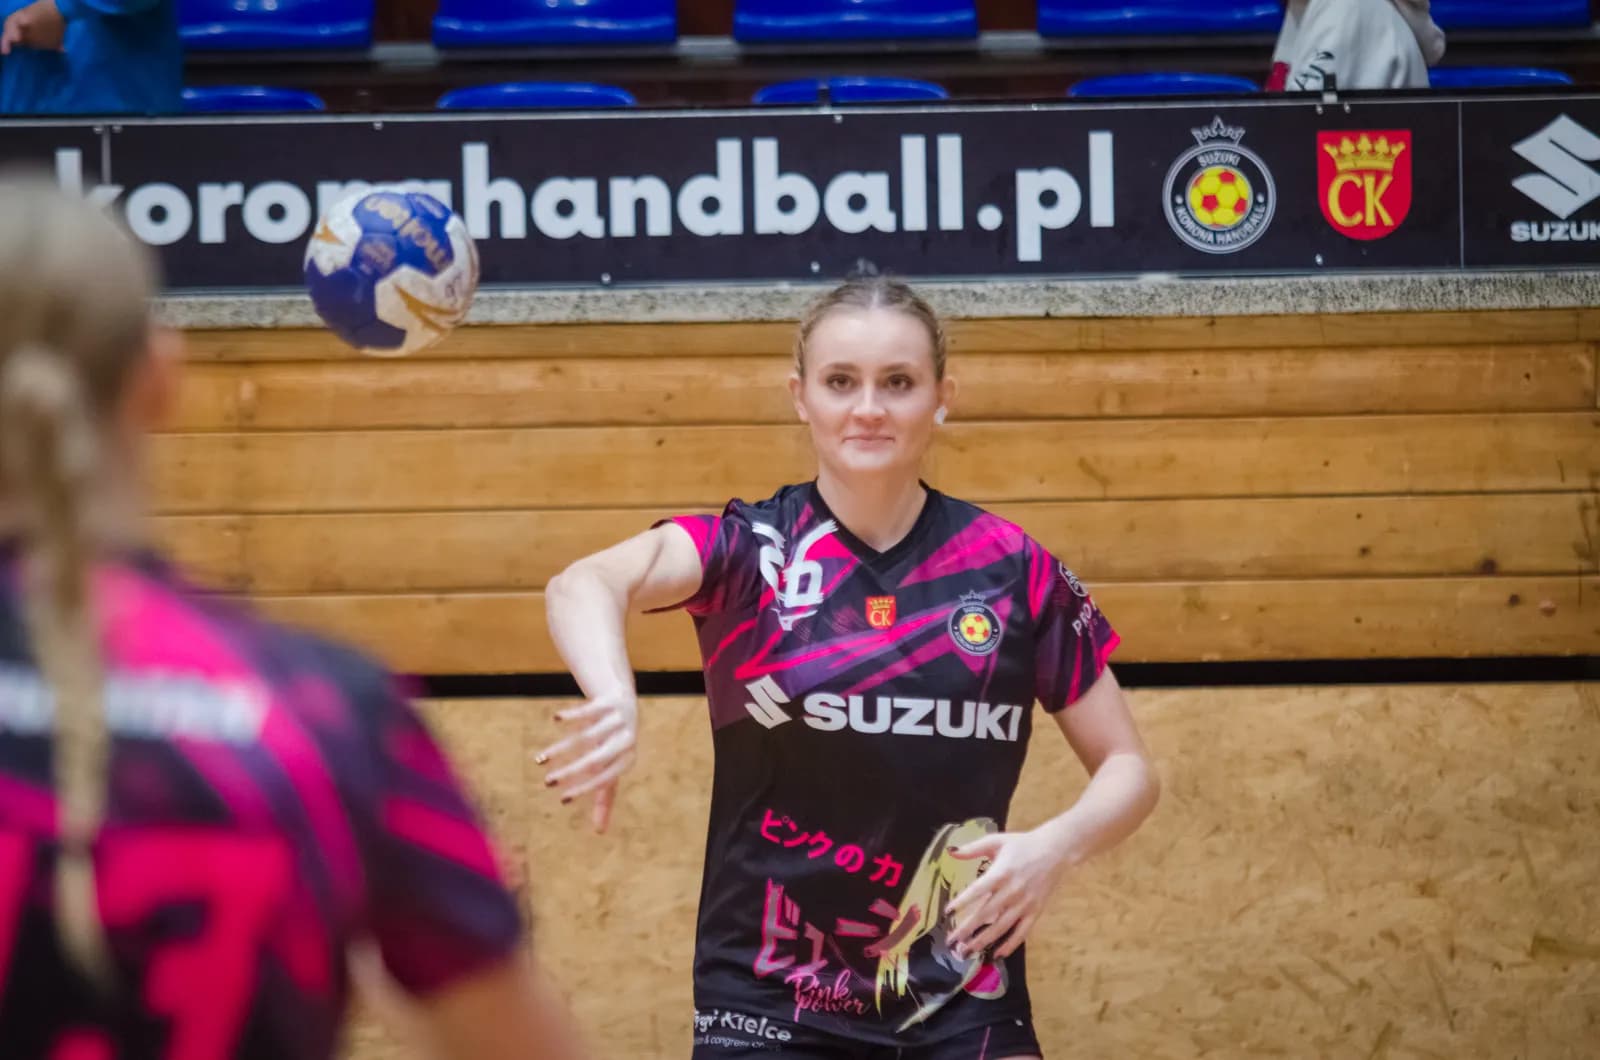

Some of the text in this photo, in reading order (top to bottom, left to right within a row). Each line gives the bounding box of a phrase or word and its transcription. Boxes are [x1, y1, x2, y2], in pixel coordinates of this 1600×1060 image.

[1197, 151, 1240, 167] SUZUKI
[55, 131, 1115, 264] korohandball.pl
[1327, 172, 1395, 229] CK
[1175, 204, 1267, 244] KORONA HANDBALL
[1510, 220, 1600, 242] SUZUK
[870, 609, 892, 627] CK
[1072, 597, 1097, 637] PRO
[803, 692, 1023, 742] SUZUKI
[760, 808, 904, 888] ピンクの力
[784, 968, 852, 1004] Pink
[721, 1011, 792, 1042] Kielce
